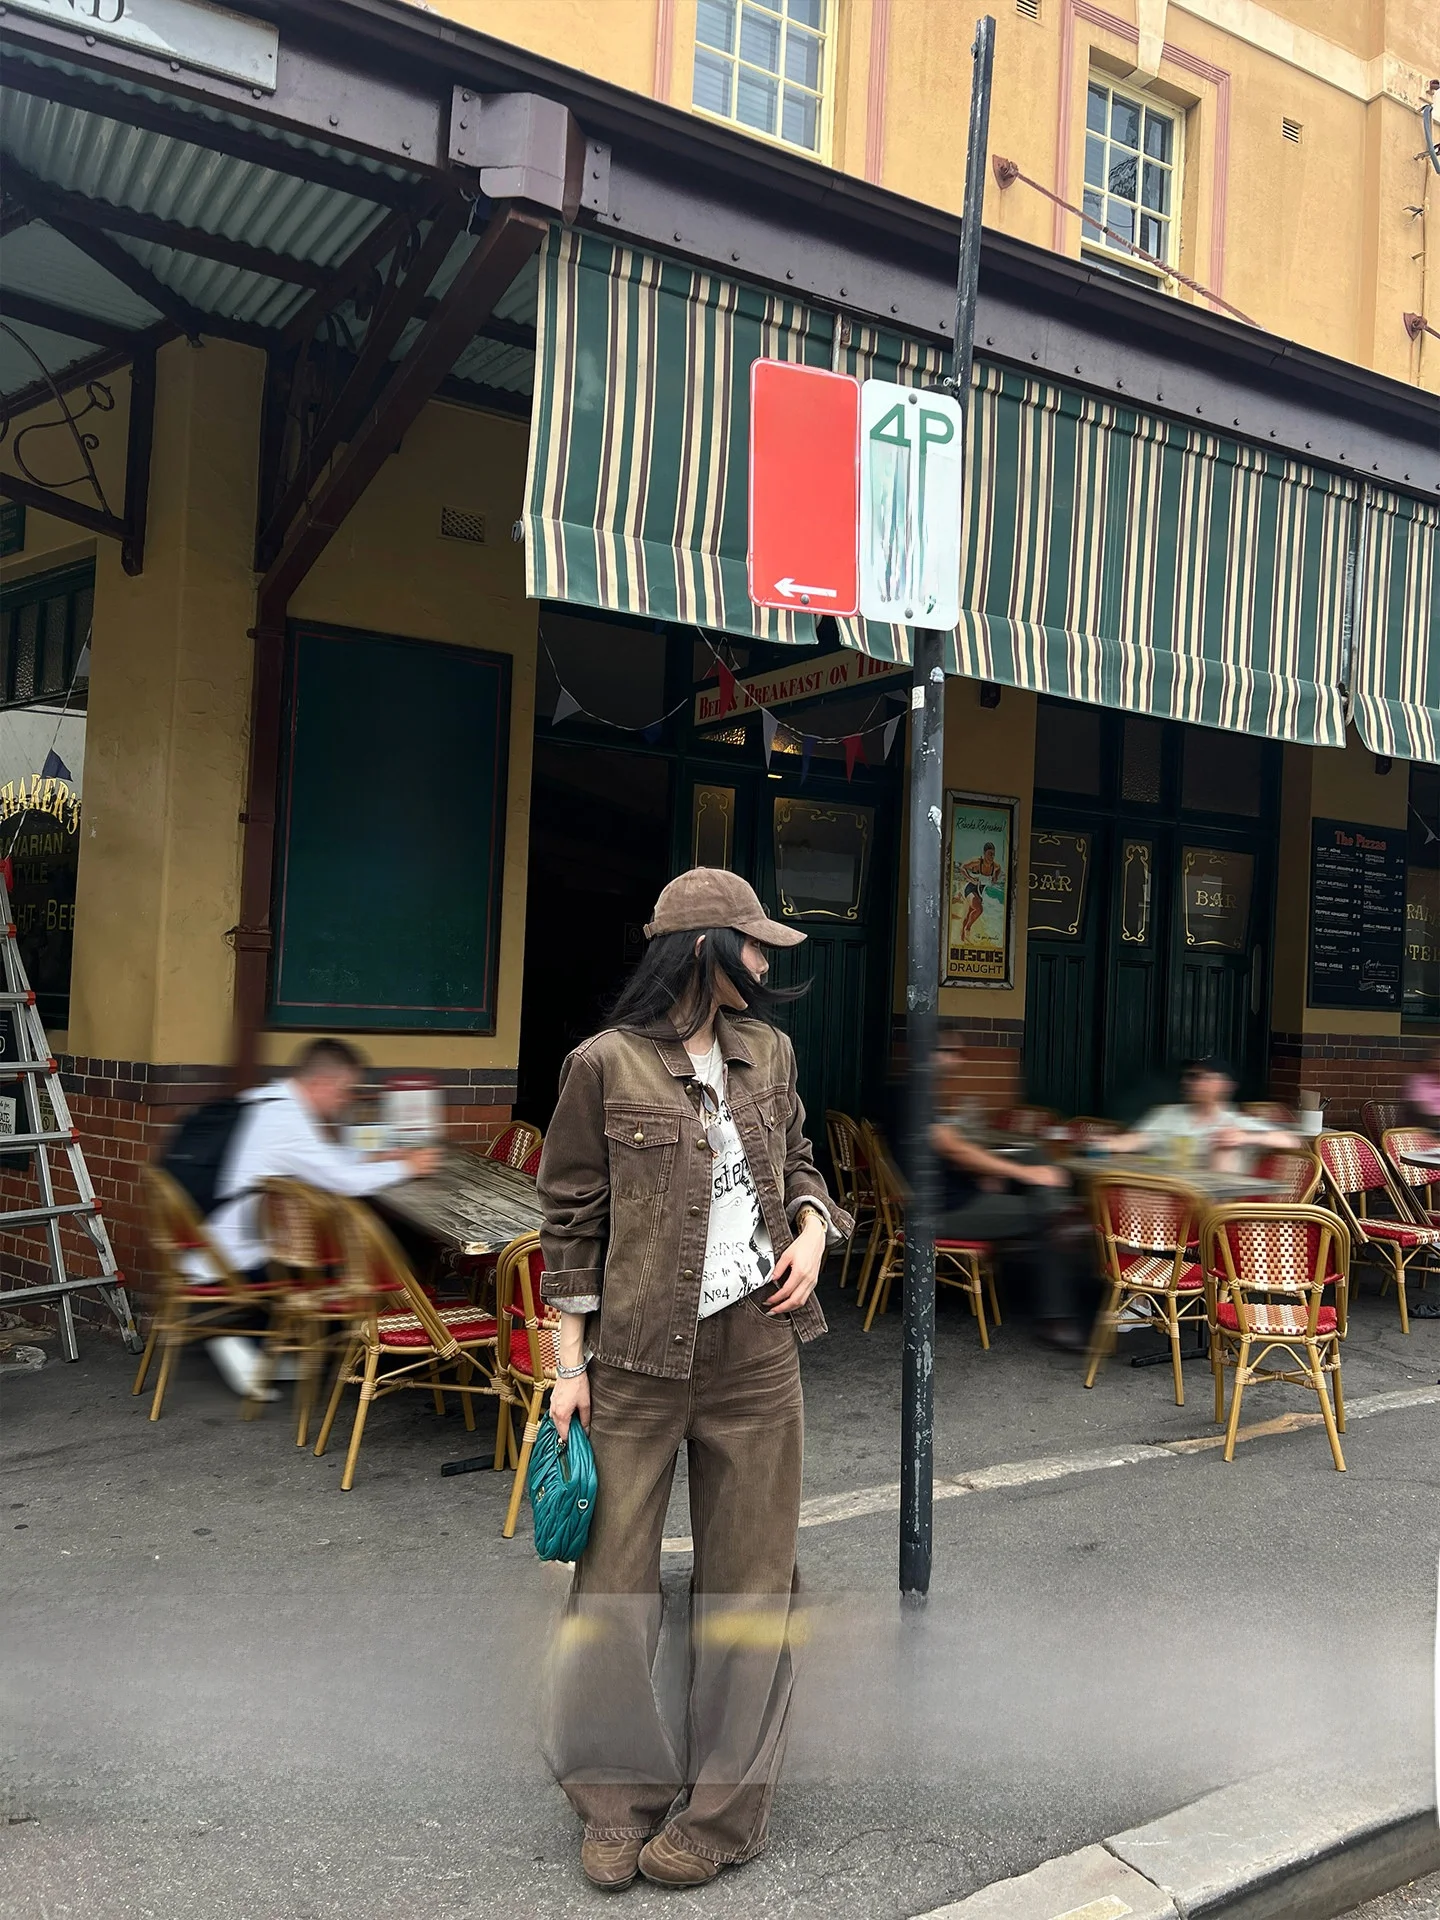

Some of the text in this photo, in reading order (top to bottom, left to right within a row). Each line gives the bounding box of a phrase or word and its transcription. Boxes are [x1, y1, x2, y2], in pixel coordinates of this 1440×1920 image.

[869, 402, 955, 457] 4P
[744, 670, 824, 709] BREAKFAST
[0, 832, 63, 858] AVARIAN
[1334, 830, 1387, 851] The Pizzas
[14, 862, 48, 885] TYLE
[1195, 890, 1237, 909] BAR
[1404, 944, 1440, 961] TEL
[949, 962, 1003, 974] DRAUGHT
